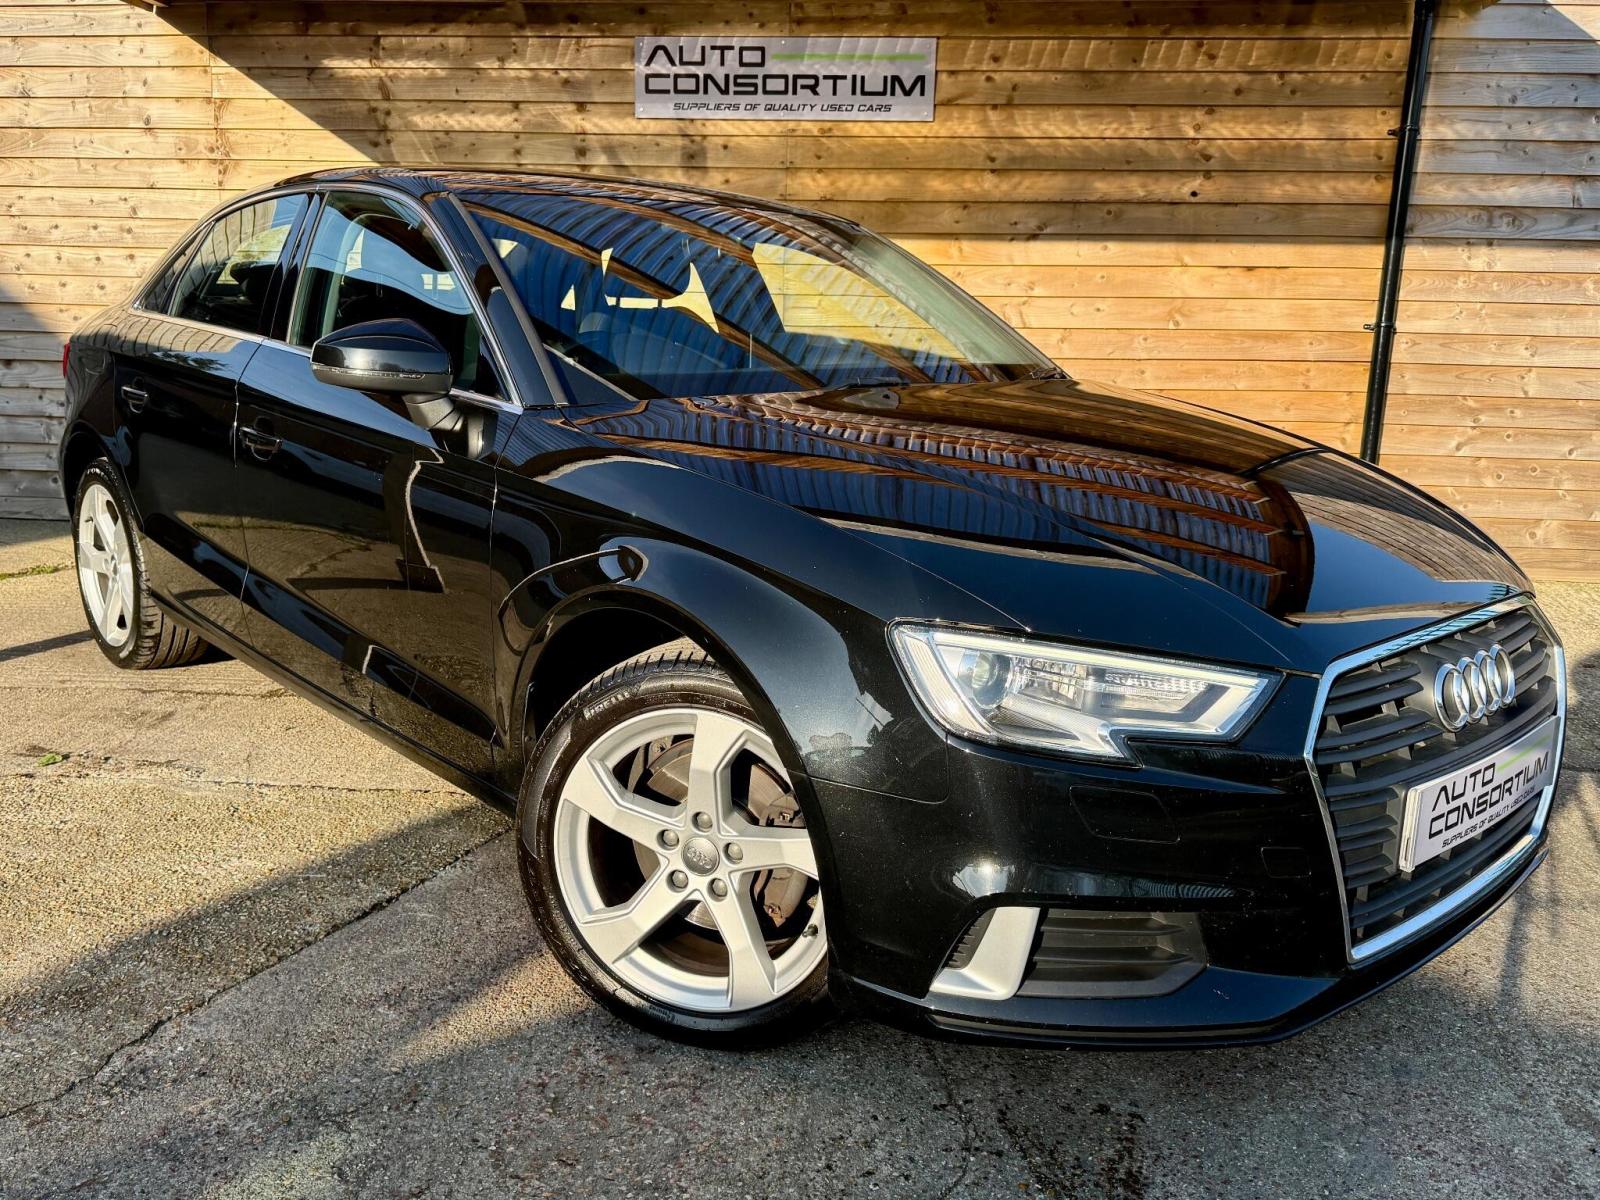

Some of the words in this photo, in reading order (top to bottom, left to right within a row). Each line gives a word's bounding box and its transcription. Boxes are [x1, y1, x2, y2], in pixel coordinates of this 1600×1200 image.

[645, 45, 766, 68] AUTO
[644, 73, 926, 97] CONSORTIUM
[673, 102, 742, 112] SUPPLIERS
[744, 103, 761, 112] OF
[763, 103, 817, 113] QUALITY
[820, 103, 854, 112] USED
[857, 104, 892, 113] CARS
[1428, 751, 1549, 840] CONSORTIUM
[1431, 762, 1496, 812] AUTO
[1442, 822, 1479, 848] SUPPLIERS
[1478, 818, 1488, 828] OF
[1487, 804, 1510, 823] QUALITY
